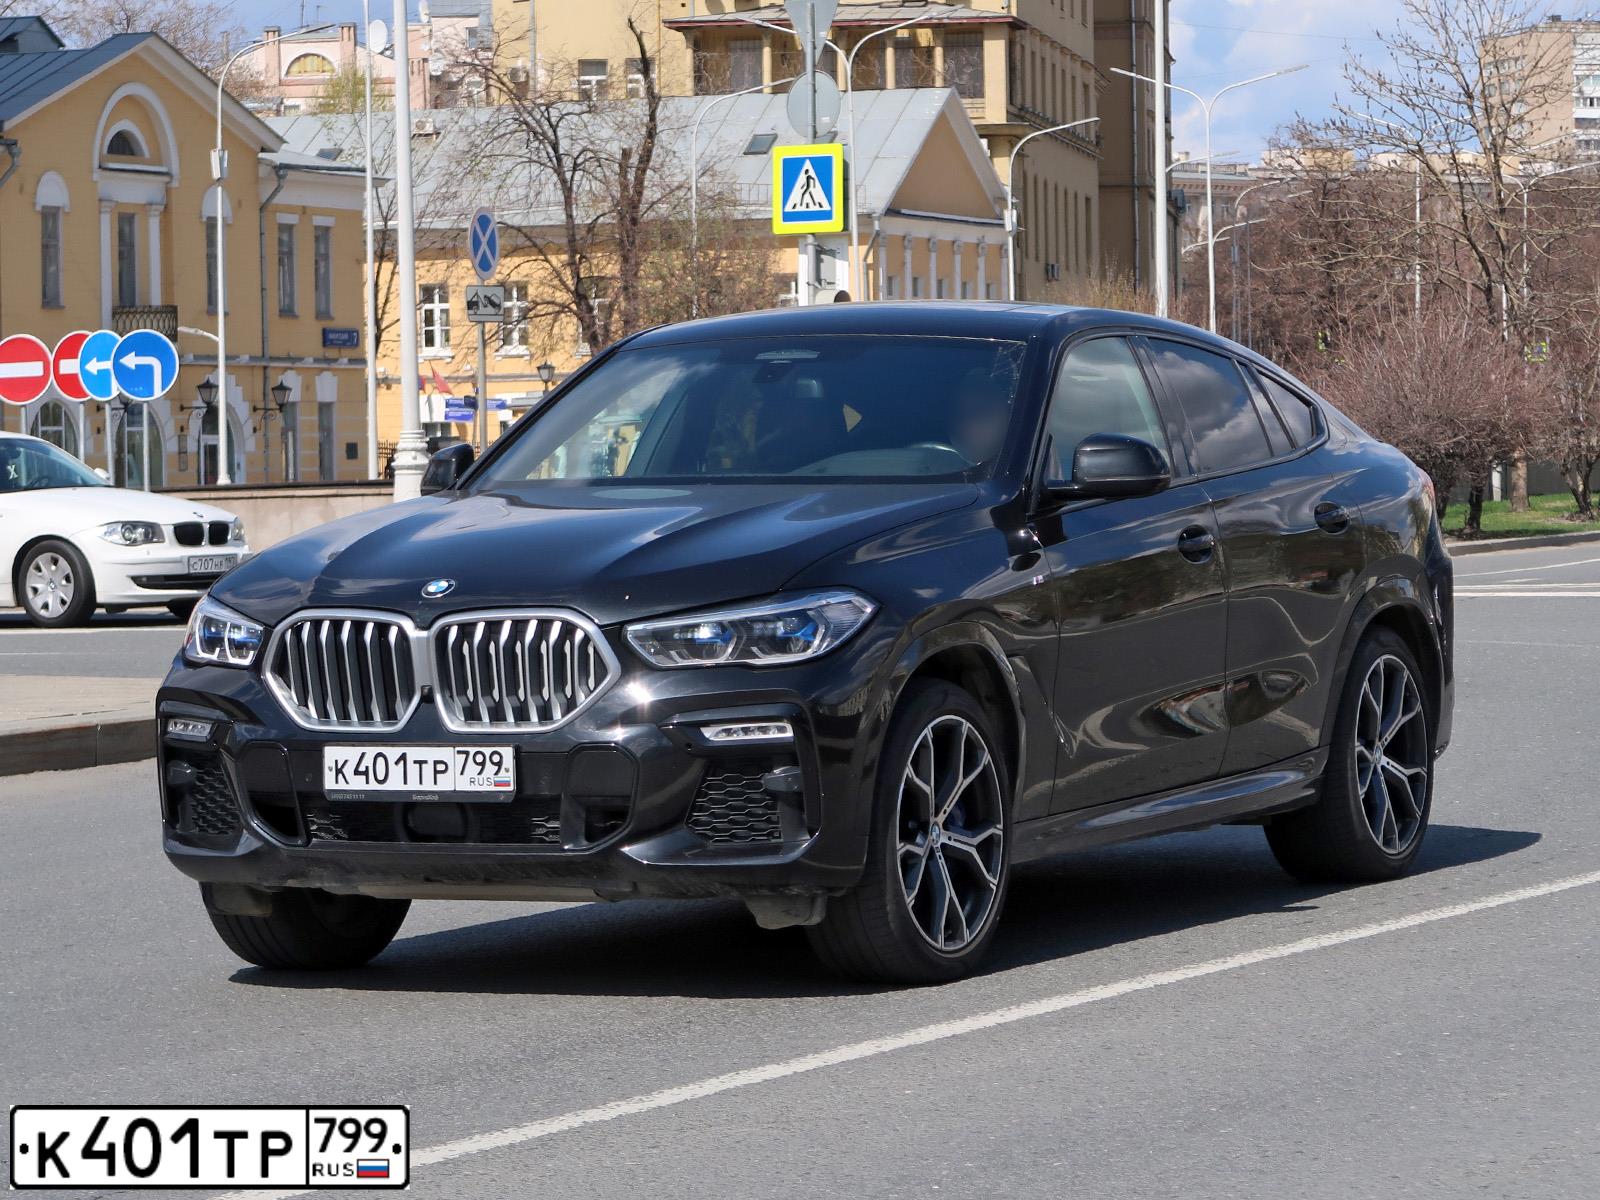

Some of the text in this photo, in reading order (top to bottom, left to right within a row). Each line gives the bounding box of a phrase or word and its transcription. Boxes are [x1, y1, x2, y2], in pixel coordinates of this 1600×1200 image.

[334, 750, 504, 785] К401ТР 799
[469, 777, 493, 787] RUS
